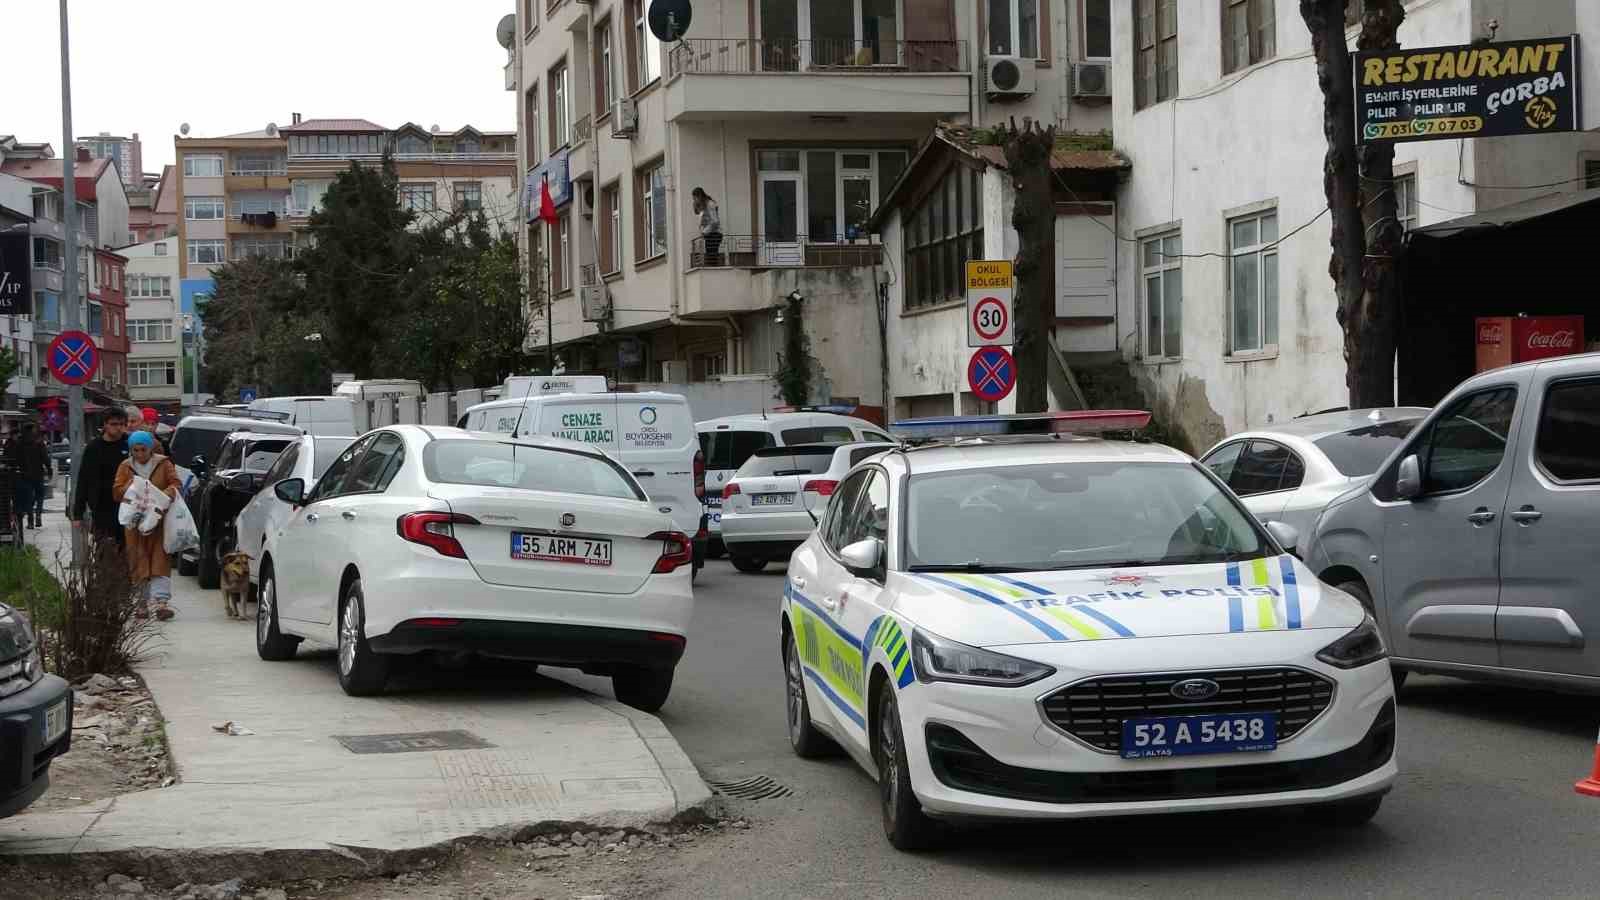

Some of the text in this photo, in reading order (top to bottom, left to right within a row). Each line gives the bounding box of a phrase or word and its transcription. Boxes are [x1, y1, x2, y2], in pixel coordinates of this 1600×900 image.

[1363, 43, 1565, 86] RESTAURANT
[1486, 71, 1566, 115] ÇORBA
[976, 265, 1002, 273] OKUL
[980, 309, 1001, 328] 30
[562, 412, 602, 427] CENAZE
[584, 429, 614, 443] ARACI
[522, 537, 540, 553] 55
[548, 539, 576, 556] ARM
[584, 541, 608, 559] 741
[1015, 589, 1149, 609] TRAFİK
[1182, 683, 1209, 696] Ford
[1135, 718, 1265, 746] 52 A 5438
